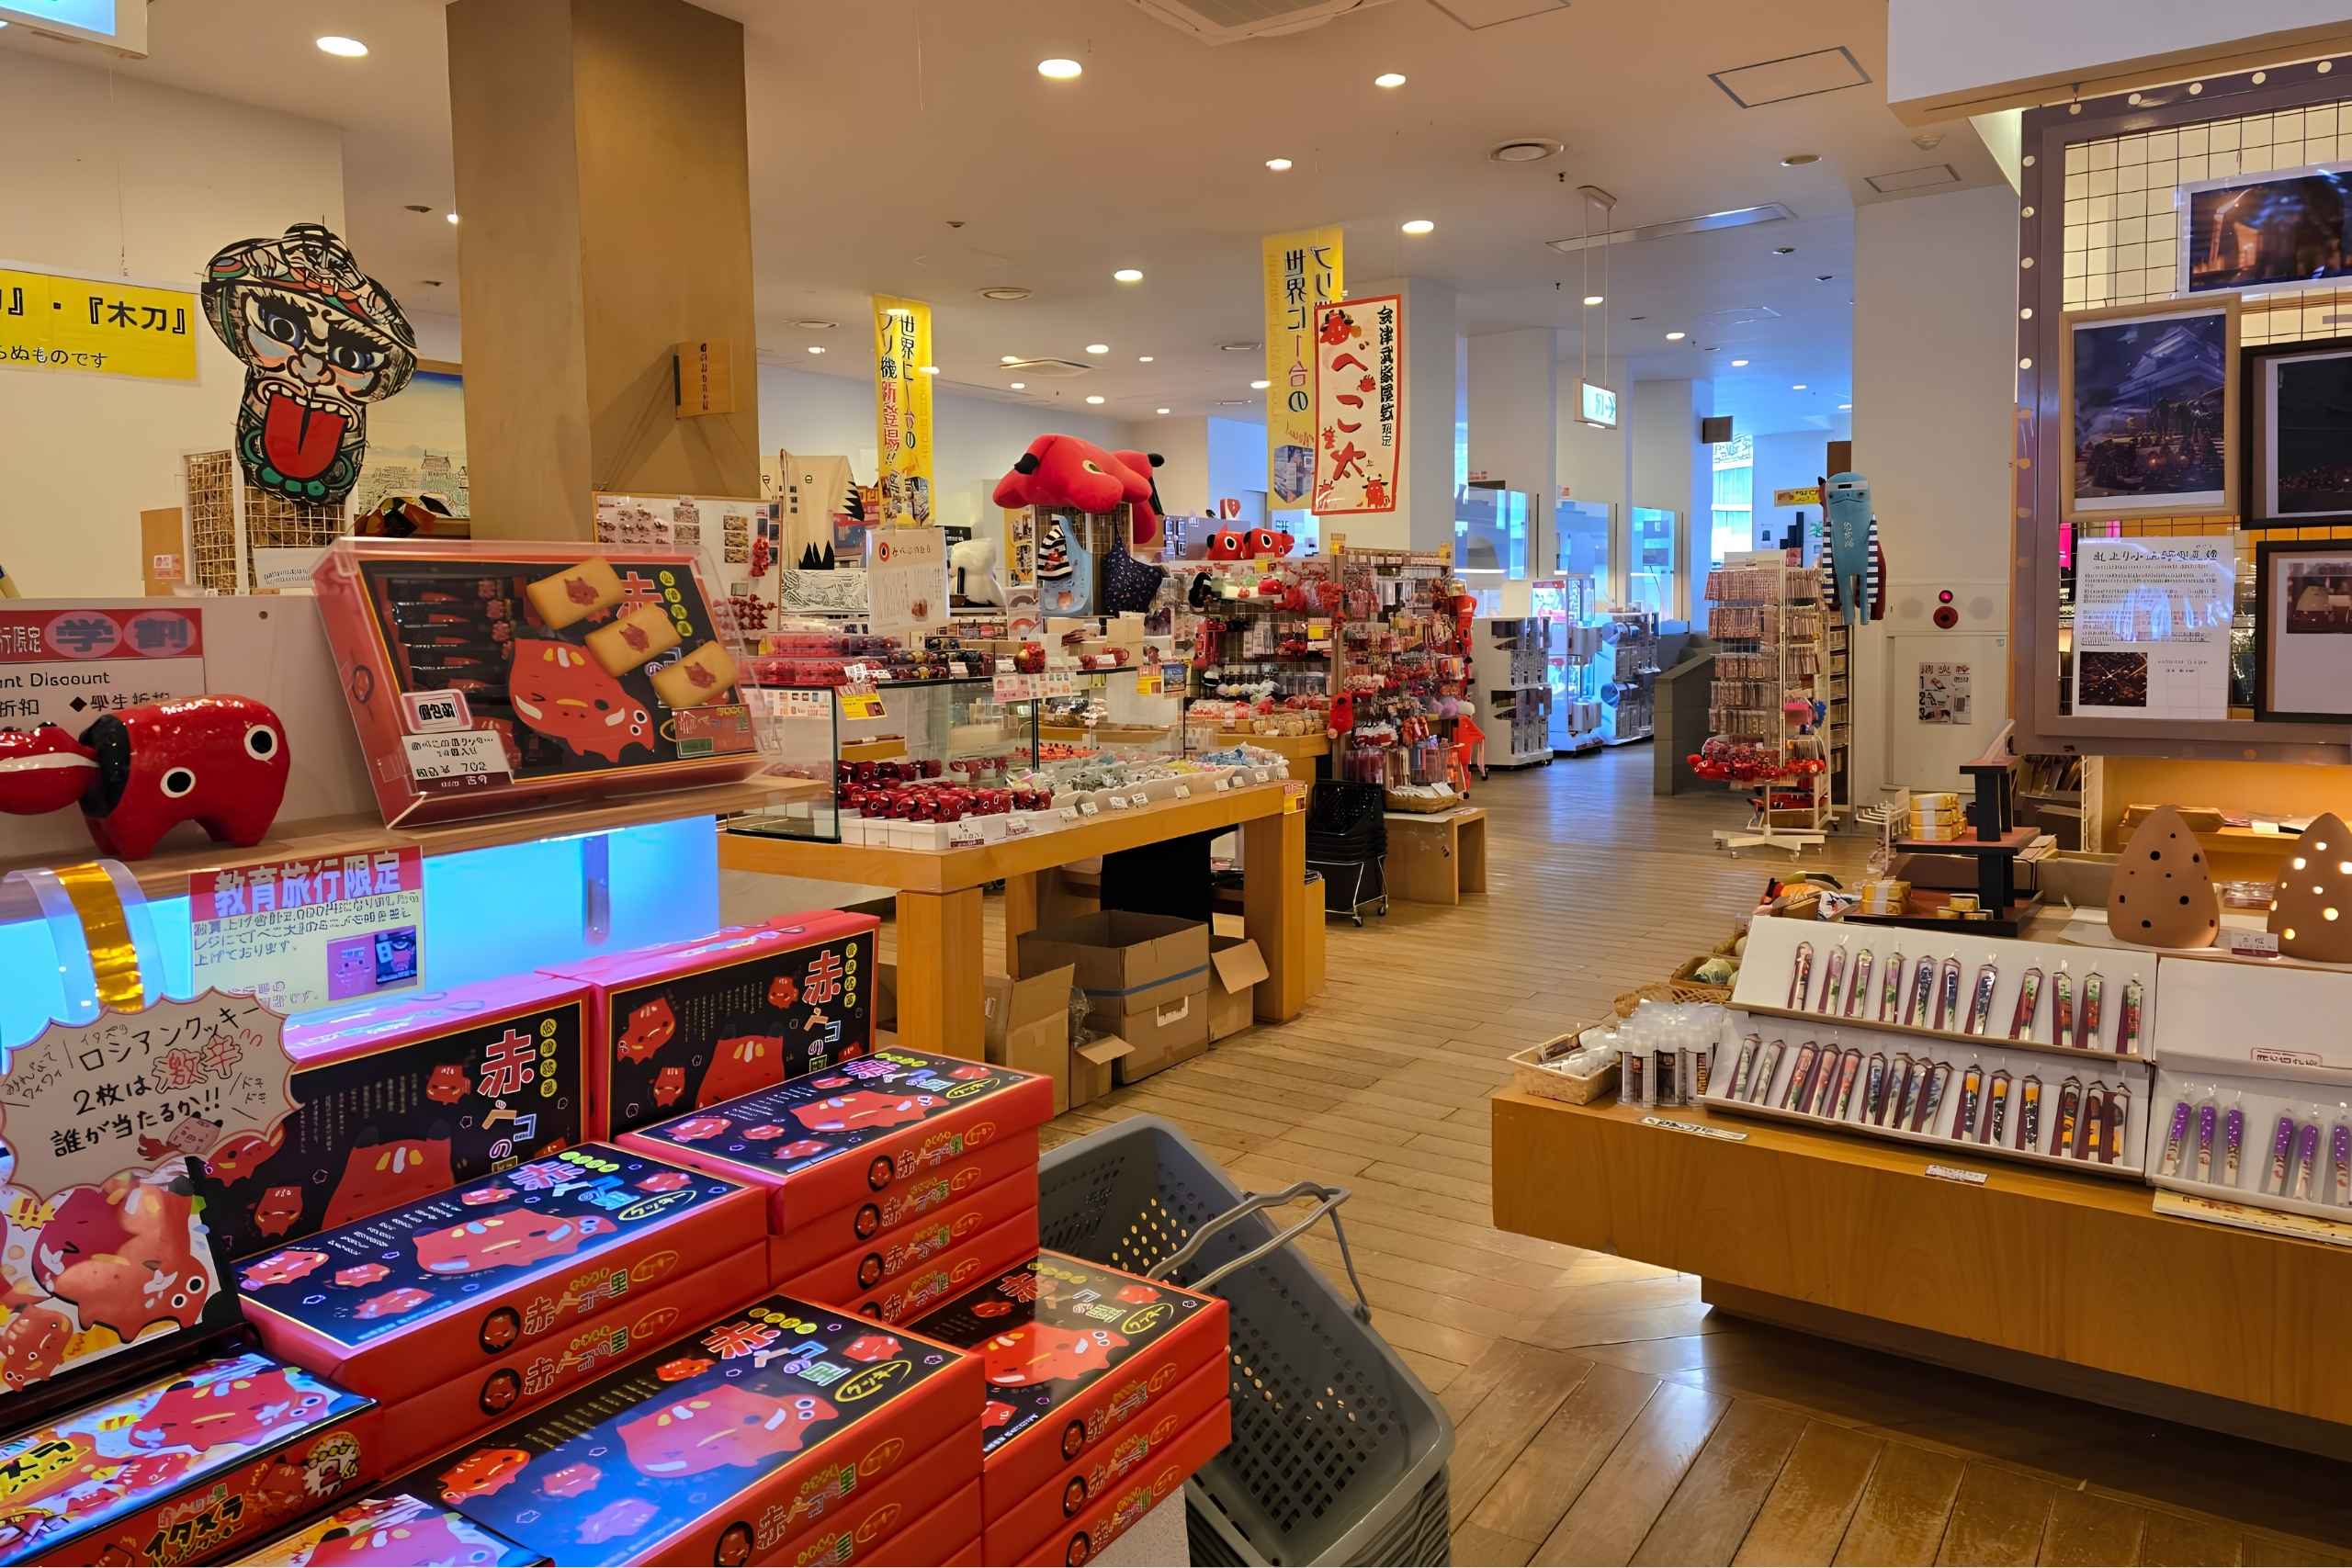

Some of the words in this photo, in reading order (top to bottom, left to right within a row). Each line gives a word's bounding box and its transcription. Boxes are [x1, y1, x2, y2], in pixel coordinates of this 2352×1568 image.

[213, 851, 401, 919] 教育旅行限定
[79, 1007, 260, 1071] ロシアンクッキー
